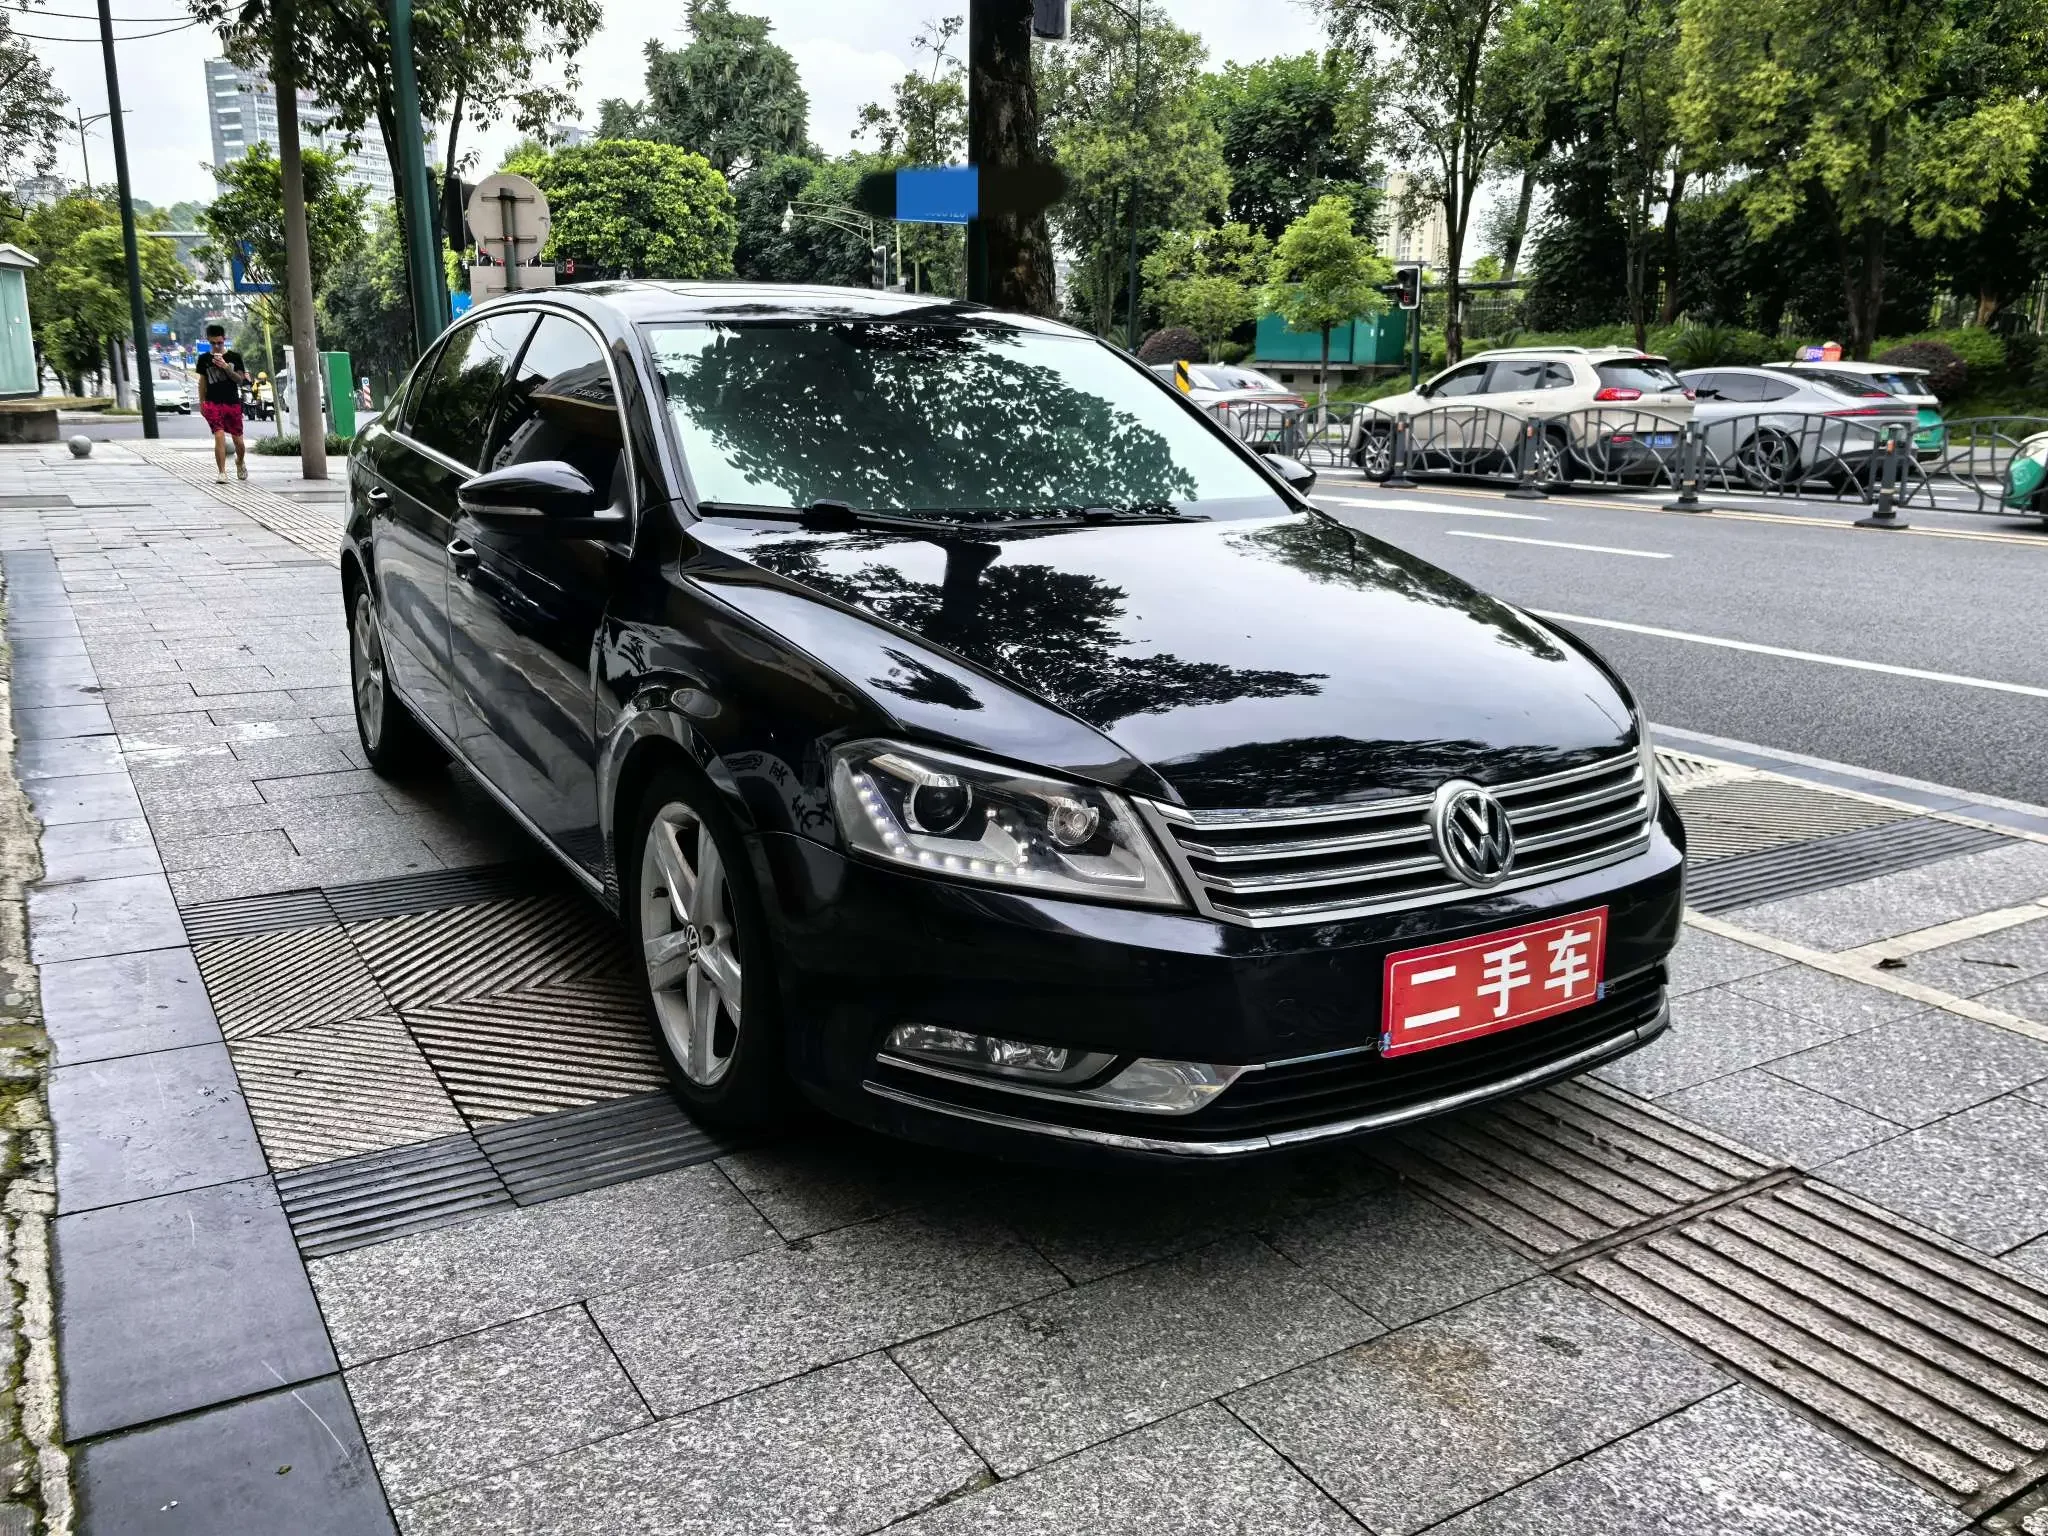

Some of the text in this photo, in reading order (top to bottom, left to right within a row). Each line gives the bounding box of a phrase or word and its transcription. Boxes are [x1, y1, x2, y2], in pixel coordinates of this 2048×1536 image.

[1443, 788, 1511, 882] VW
[1404, 929, 1591, 1029] 二手车
